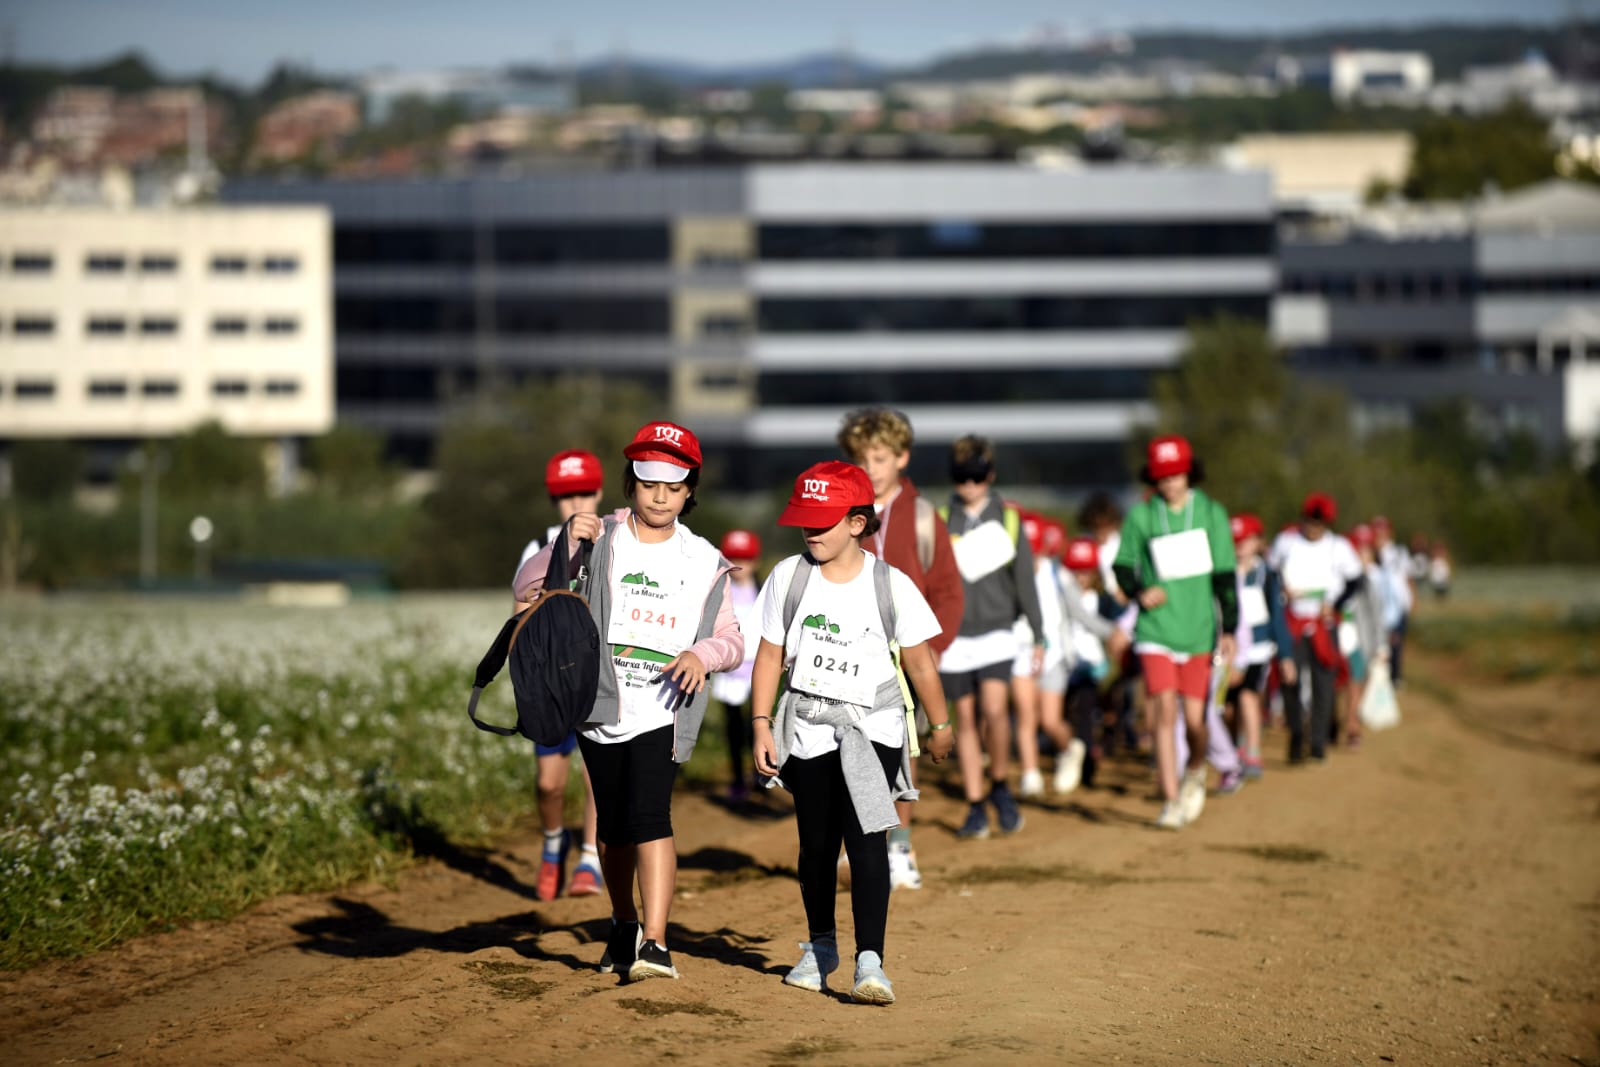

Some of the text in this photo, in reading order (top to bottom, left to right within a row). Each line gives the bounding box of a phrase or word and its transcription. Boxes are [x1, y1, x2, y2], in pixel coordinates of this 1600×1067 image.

[655, 426, 684, 441] TOT
[804, 479, 829, 494] TOT
[631, 608, 677, 629] 0241
[613, 658, 640, 669] Marxa
[813, 654, 860, 677] 0241
